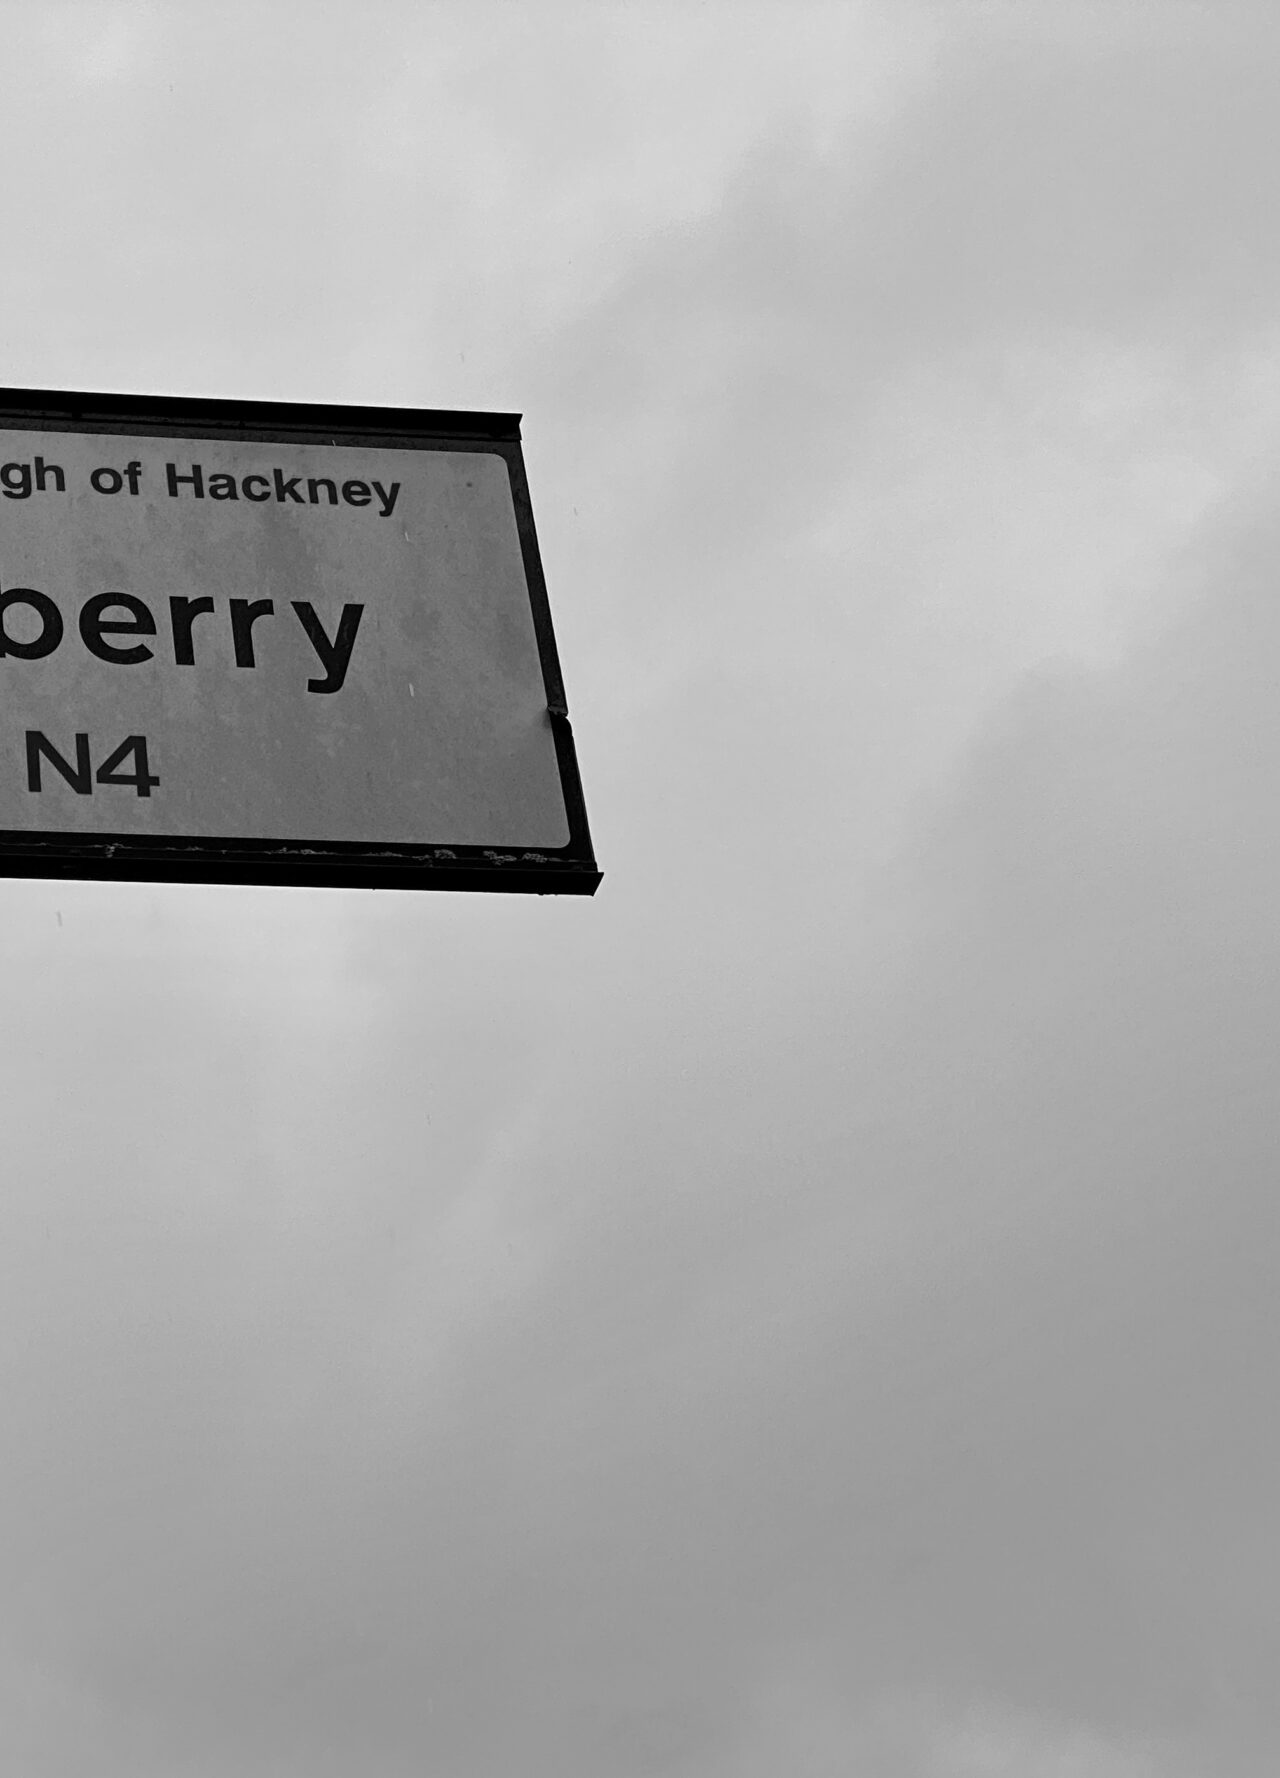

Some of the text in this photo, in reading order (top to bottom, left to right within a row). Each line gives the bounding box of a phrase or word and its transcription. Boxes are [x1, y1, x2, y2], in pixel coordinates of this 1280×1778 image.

[90, 461, 142, 496] of
[166, 463, 401, 518] Hackney
[25, 730, 161, 798] N4
